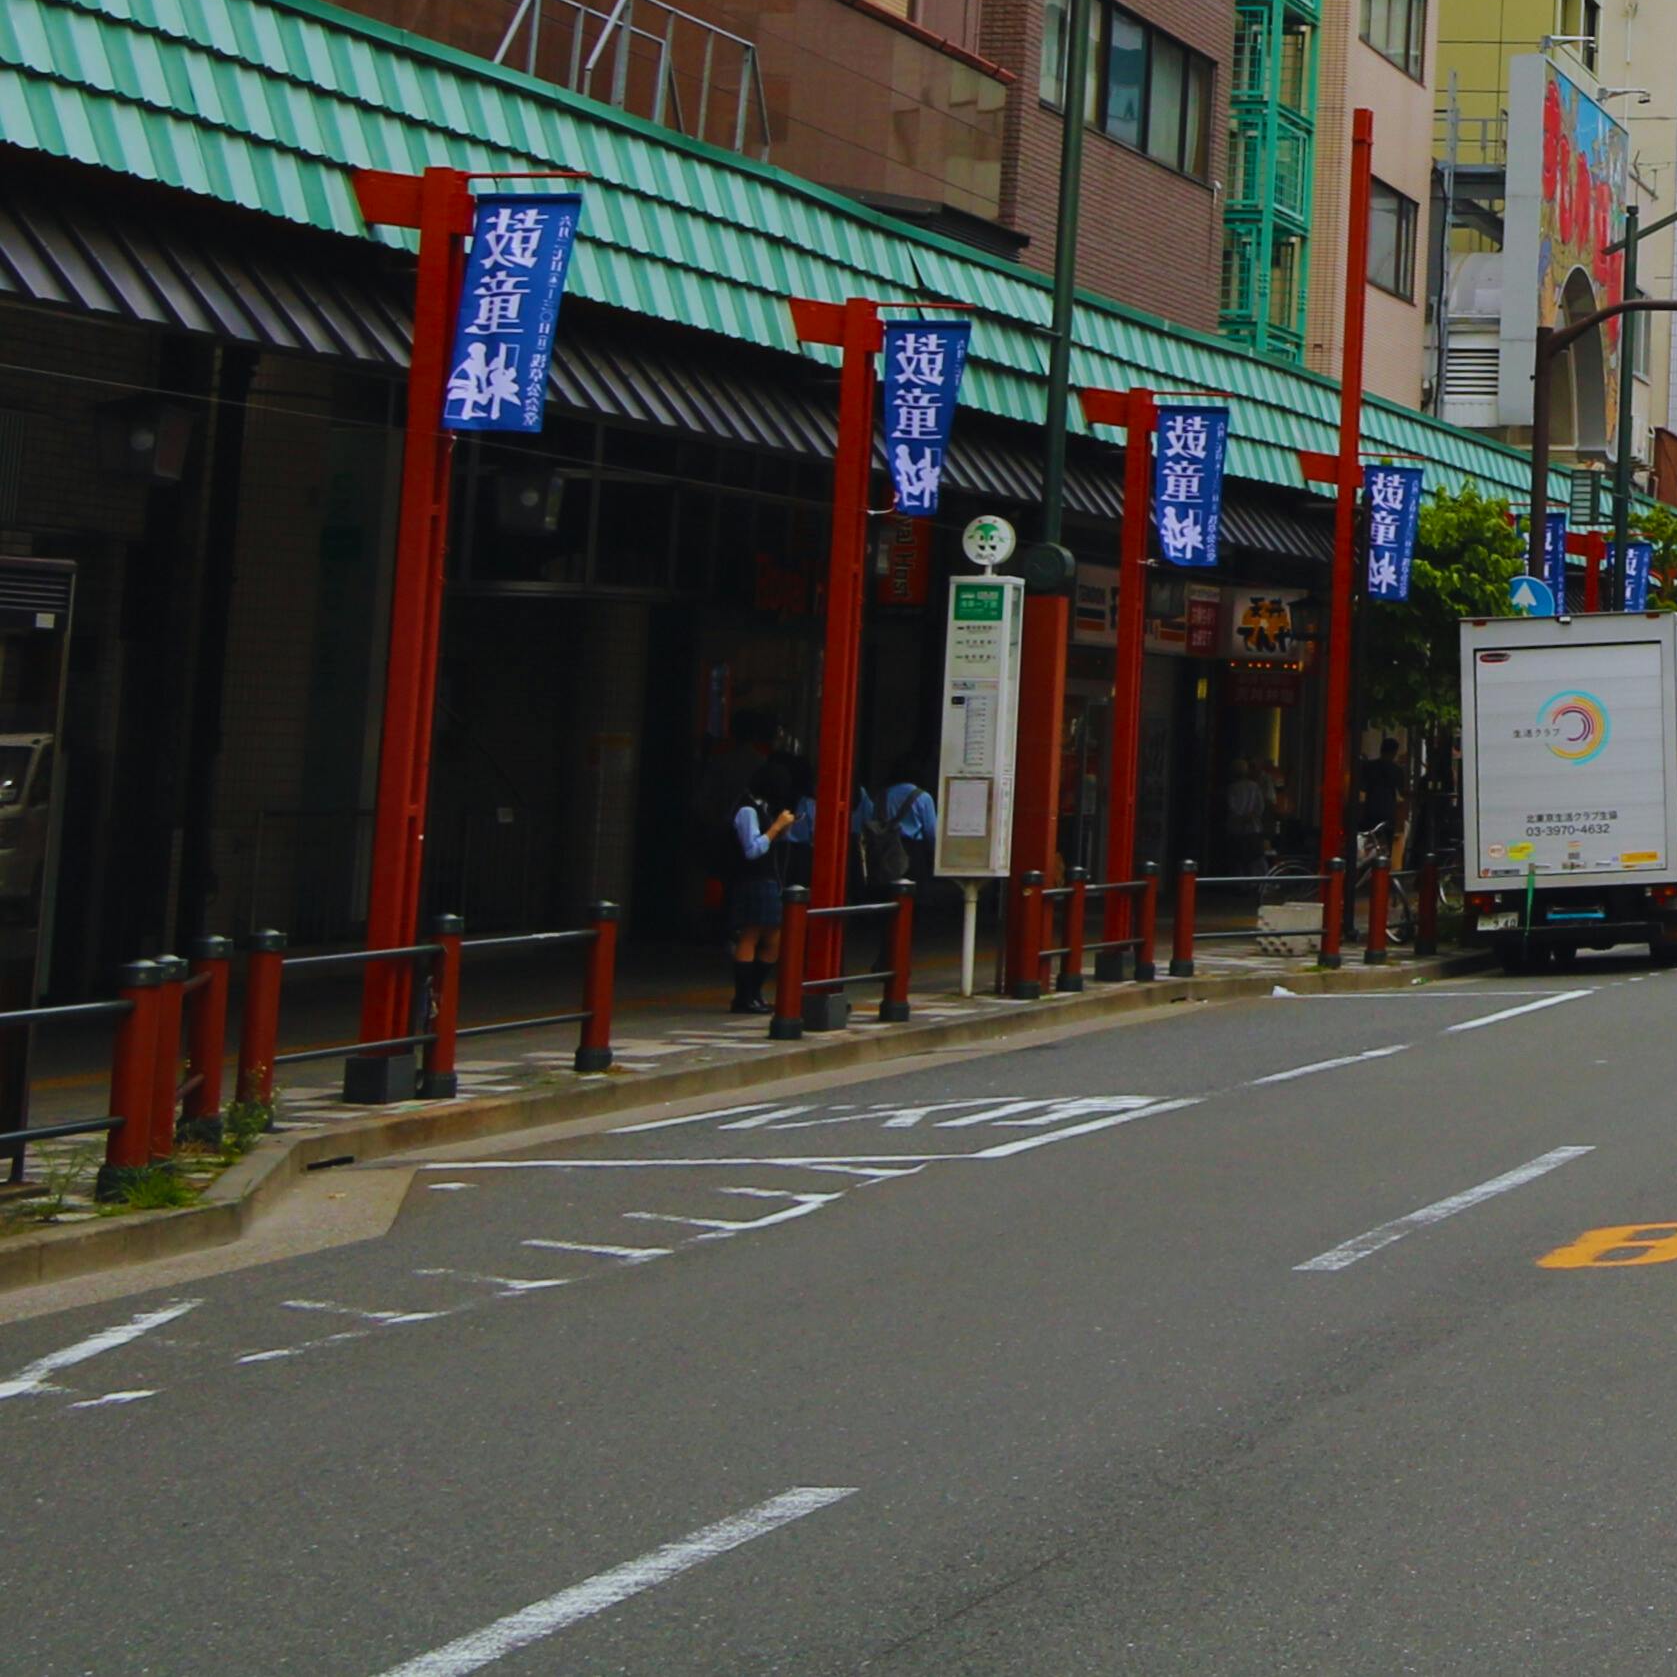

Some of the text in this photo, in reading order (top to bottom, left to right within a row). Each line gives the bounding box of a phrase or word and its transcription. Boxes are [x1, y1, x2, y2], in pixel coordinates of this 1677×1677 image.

[1513, 728, 1561, 740] 生活クラブ
[1525, 824, 1611, 837] 03-3970-4632
